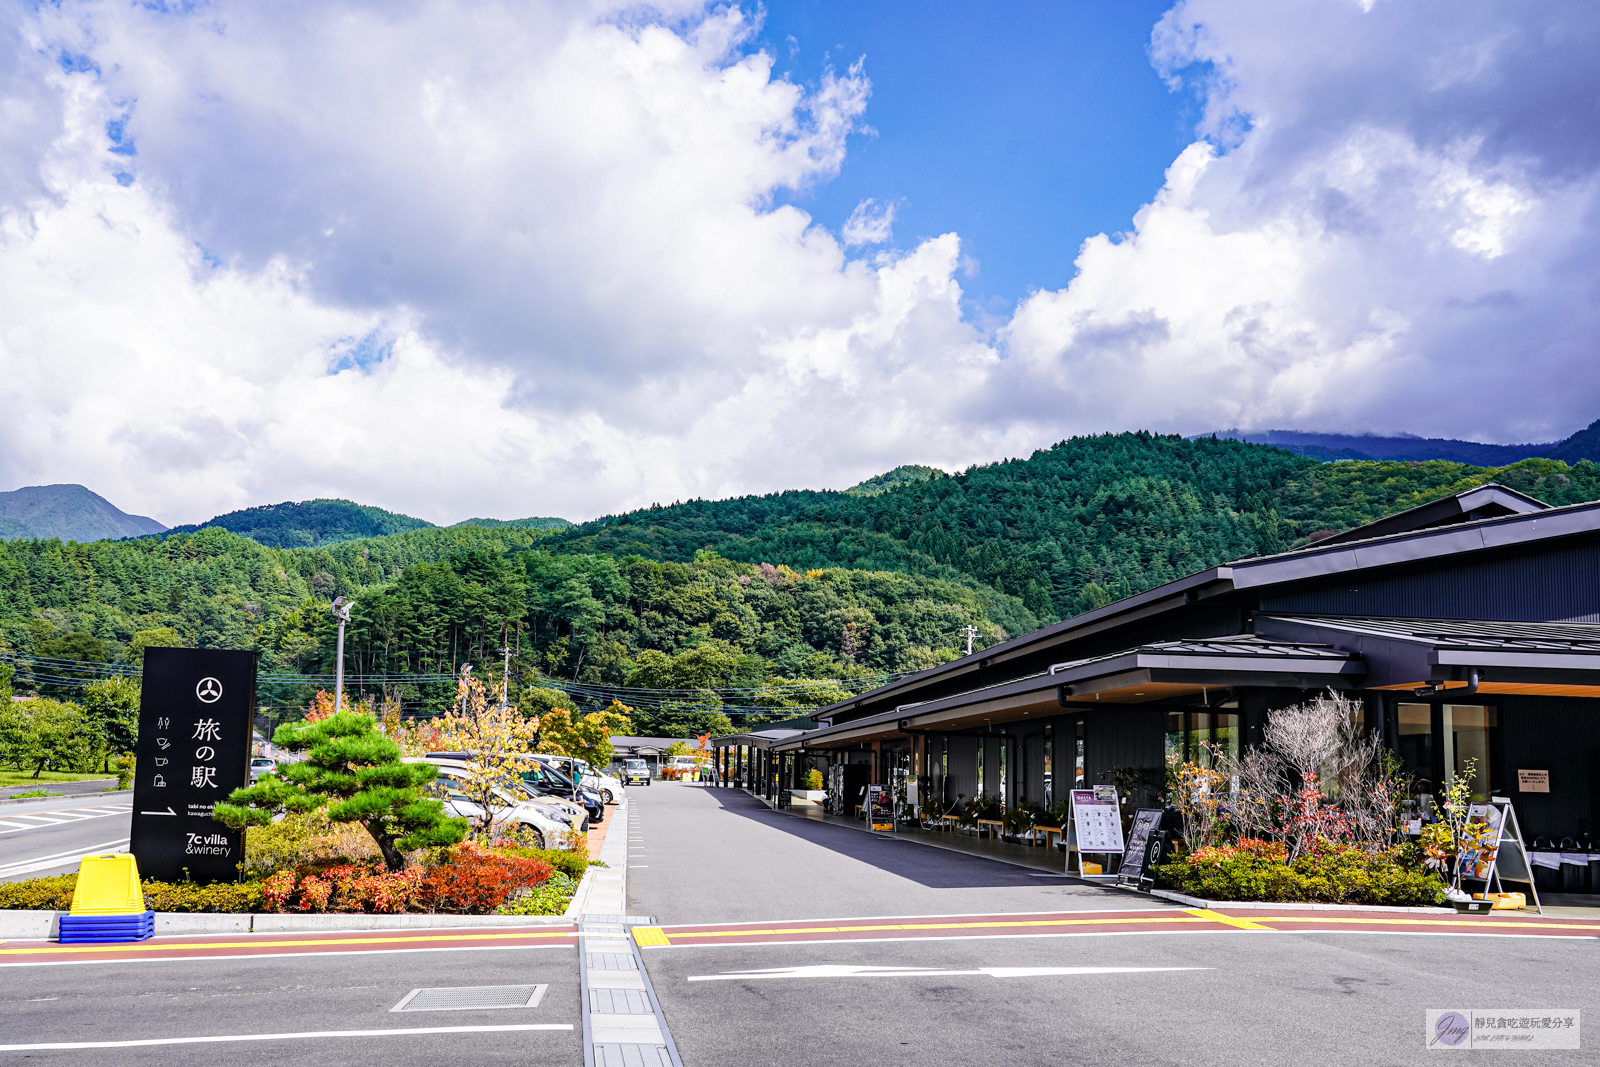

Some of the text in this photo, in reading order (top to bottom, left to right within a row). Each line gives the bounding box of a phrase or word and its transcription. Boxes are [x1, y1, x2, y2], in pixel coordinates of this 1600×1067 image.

[190, 718, 222, 789] 旅の駅
[186, 833, 228, 845] 7c villa
[185, 844, 231, 857] &winery
